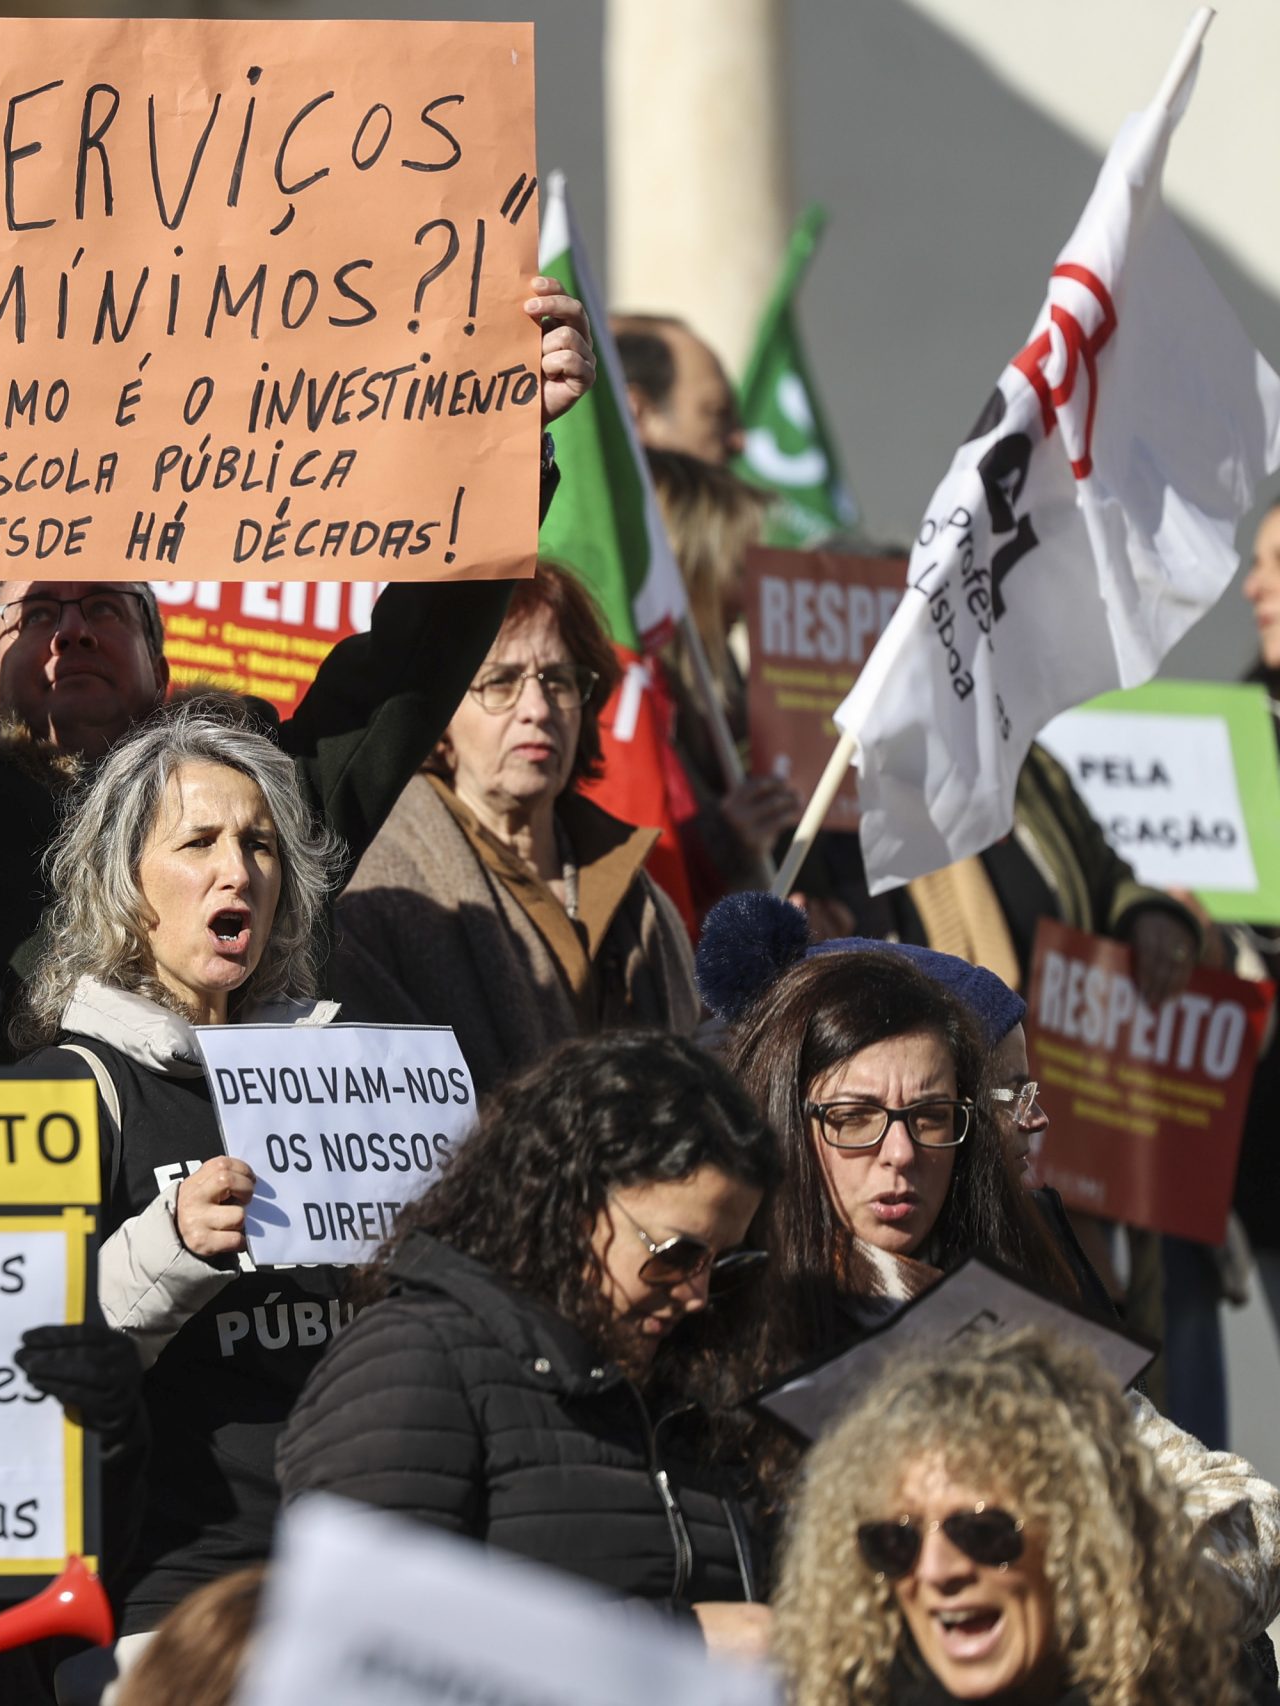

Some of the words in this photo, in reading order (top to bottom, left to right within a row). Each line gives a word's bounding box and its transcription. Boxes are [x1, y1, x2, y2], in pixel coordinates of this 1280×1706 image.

[116, 353, 151, 427] É
[184, 377, 214, 424] O
[248, 353, 539, 433] INVESTIMENTO
[153, 432, 356, 492] PÚBLICA
[126, 501, 187, 563] HÁ
[234, 485, 465, 563] DÉCADAS!
[1078, 756, 1170, 789] PELA
[1109, 811, 1237, 853] CAÇÃO
[1039, 950, 1248, 1079] RESPEITO
[216, 1066, 470, 1105] DEVOLVAM-NOS
[266, 1133, 312, 1173] OS
[320, 1133, 454, 1173] NOSSOS
[303, 1201, 404, 1241] DIREIT
